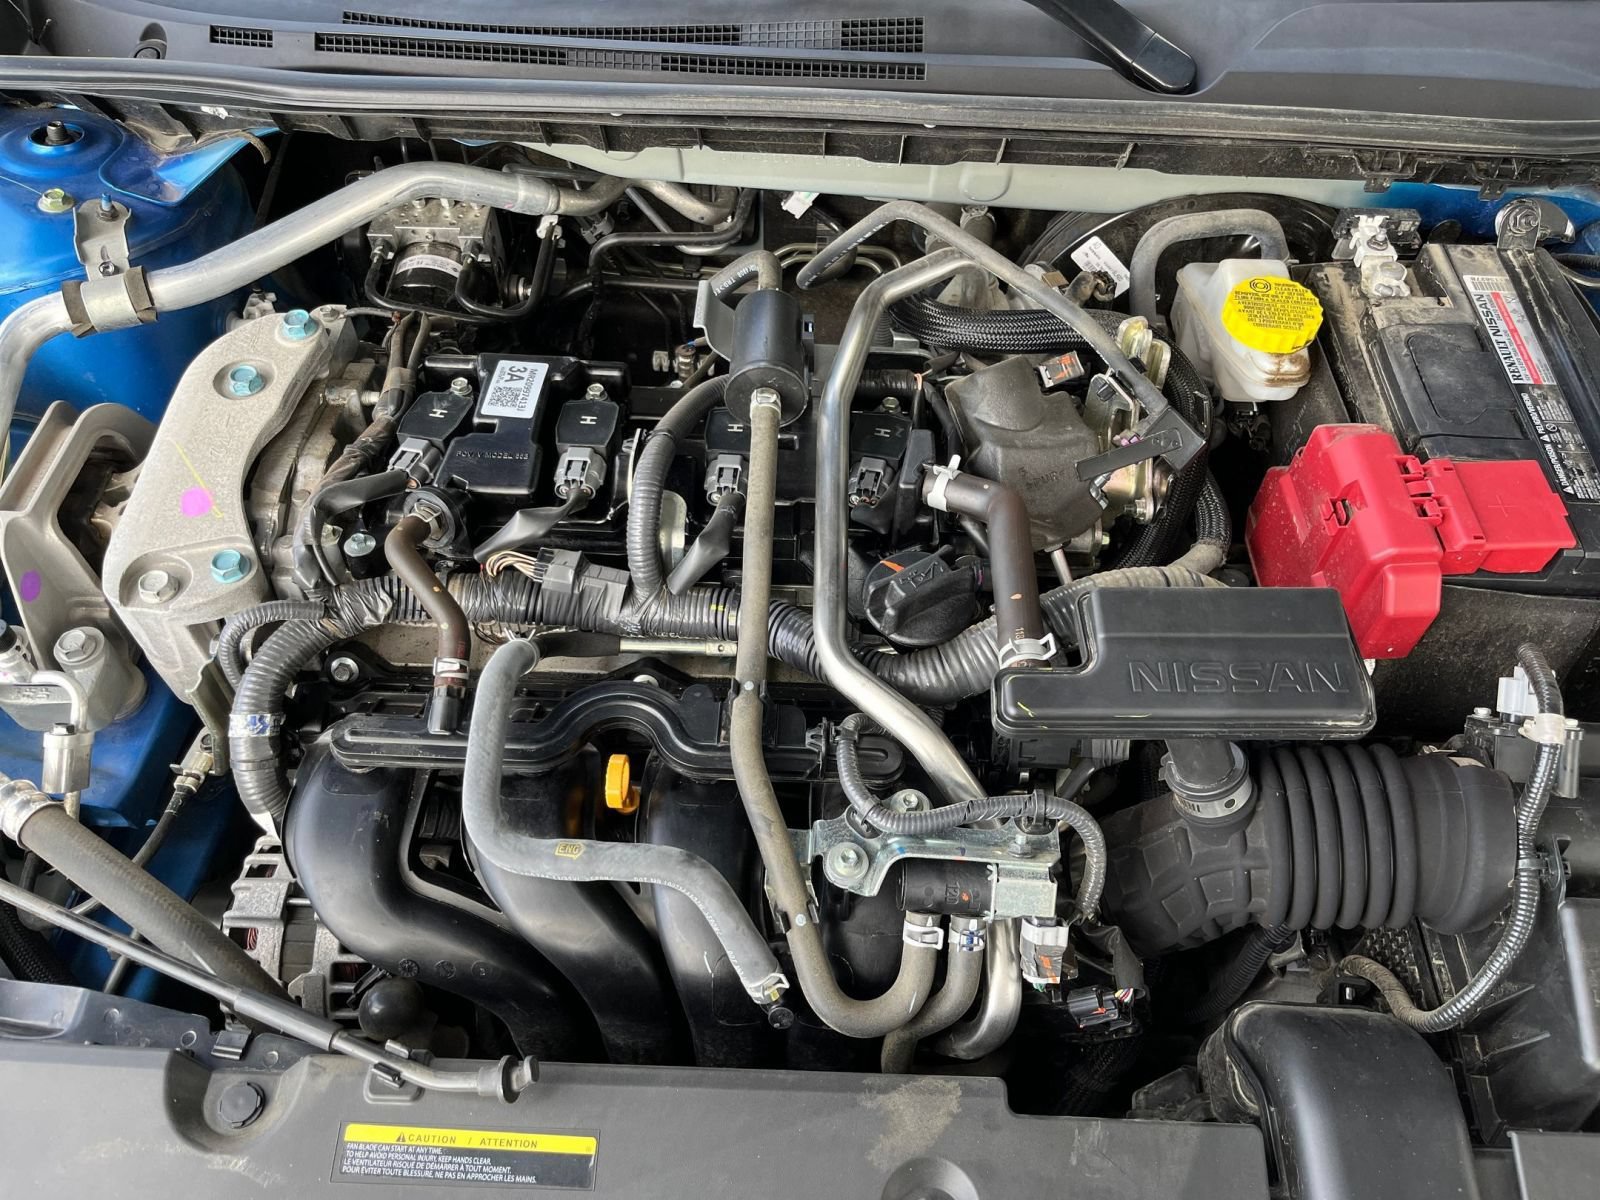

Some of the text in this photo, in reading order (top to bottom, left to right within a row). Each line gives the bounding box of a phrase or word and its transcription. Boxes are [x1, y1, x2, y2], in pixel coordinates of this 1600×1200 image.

[1474, 294, 1503, 337] NISSAN
[1496, 340, 1523, 381] RENAULT
[504, 366, 528, 382] 3A
[1128, 661, 1350, 693] NISSAN
[559, 844, 580, 854] ENG
[408, 1133, 456, 1144] CAUTION
[480, 1138, 538, 1149] ATTENTION
[346, 1143, 359, 1151] FAN
[359, 1143, 377, 1151] BLADE
[391, 1145, 407, 1153] START
[408, 1145, 416, 1153] AT
[417, 1146, 429, 1154] ANY
[429, 1147, 443, 1155] TIME.
[346, 1150, 354, 1158] TO
[387, 1152, 417, 1161] PERSONAL
[453, 1156, 472, 1164] HANDS
[473, 1157, 492, 1165] CLEAR.
[342, 1166, 360, 1174] POUR
[361, 1166, 381, 1174] ÉVITER
[382, 1168, 402, 1176] TOUTE
[444, 1171, 456, 1179] PAS
[466, 1173, 504, 1181] APPROCHER
[352, 1159, 392, 1167] VENTILATEUR
[393, 1160, 415, 1169] RISQUE
[426, 1161, 459, 1171] DÉMARRER
[465, 1164, 482, 1172] TOUT
[483, 1166, 512, 1174] MOMENT.
